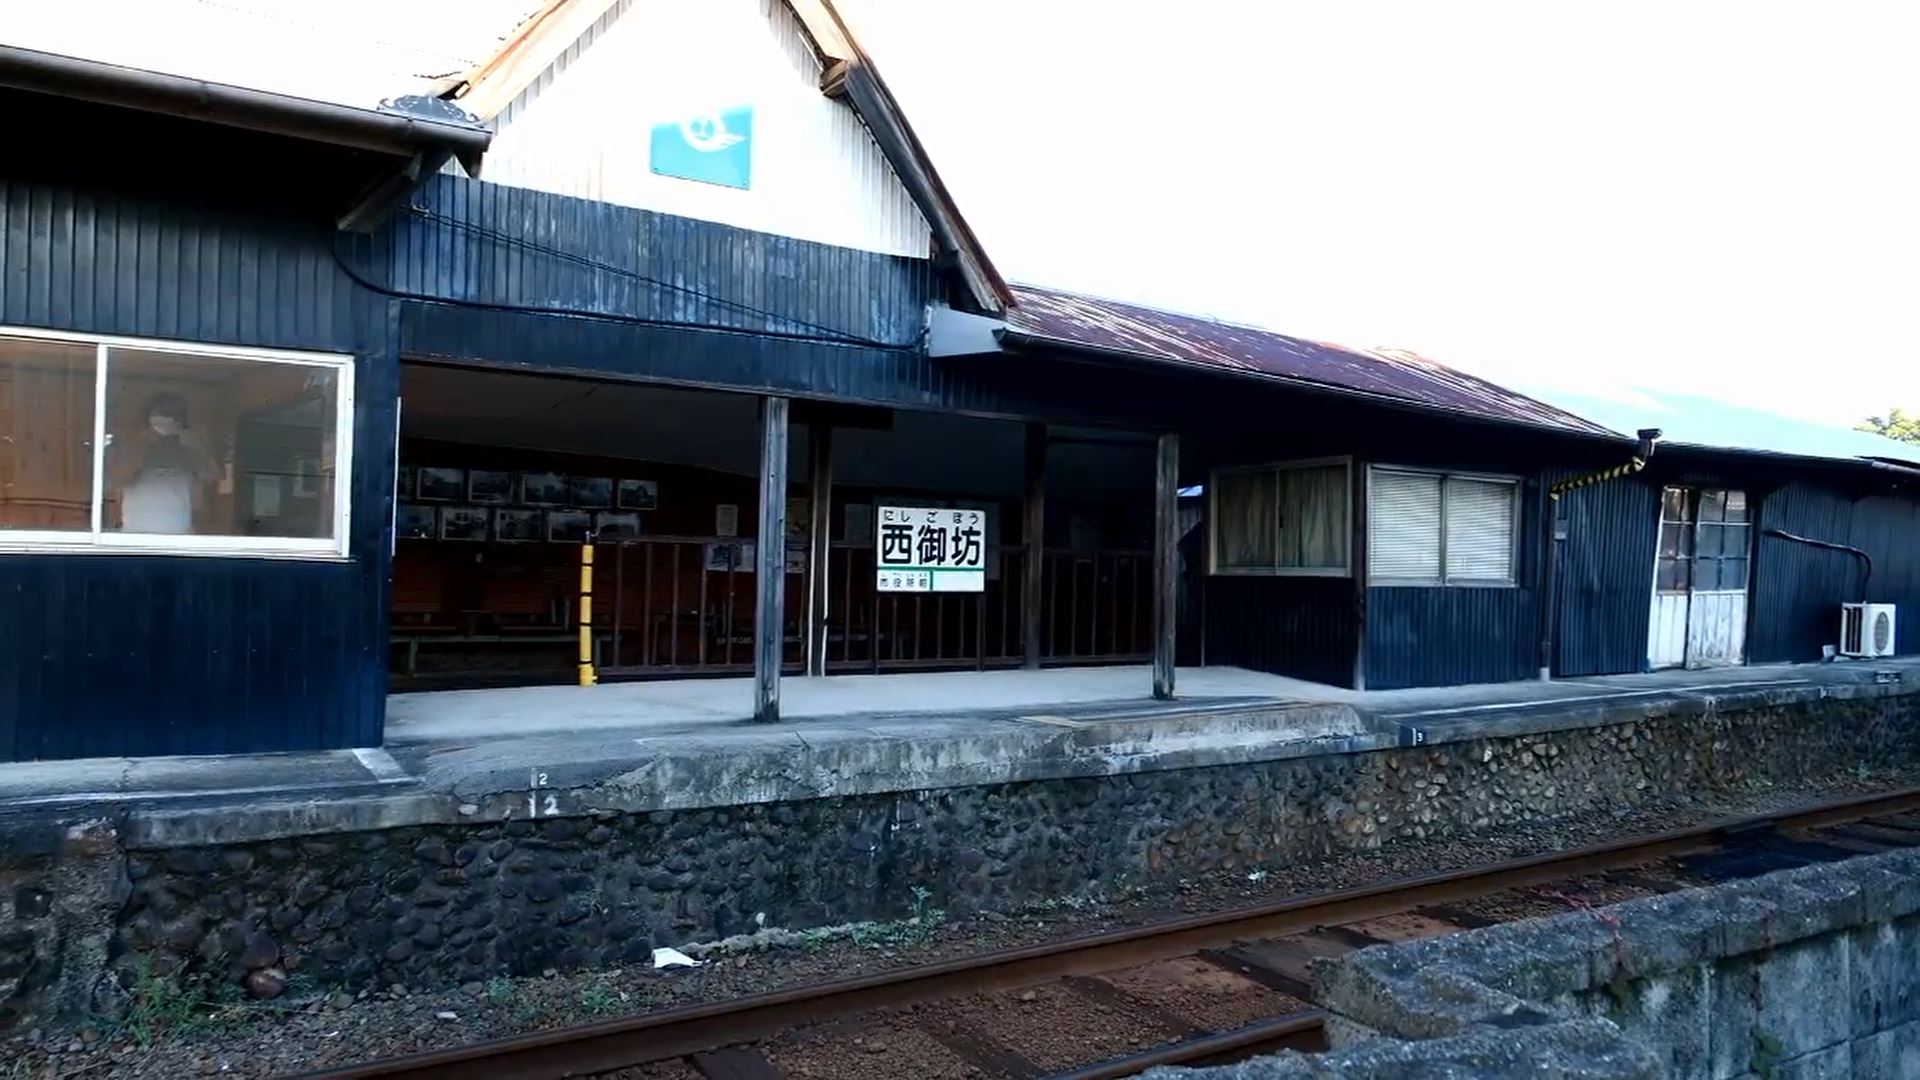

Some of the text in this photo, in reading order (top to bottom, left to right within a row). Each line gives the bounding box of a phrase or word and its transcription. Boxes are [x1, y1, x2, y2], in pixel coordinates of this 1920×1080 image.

[884, 509, 979, 525] にしごぼう
[882, 524, 981, 566] 西御坊
